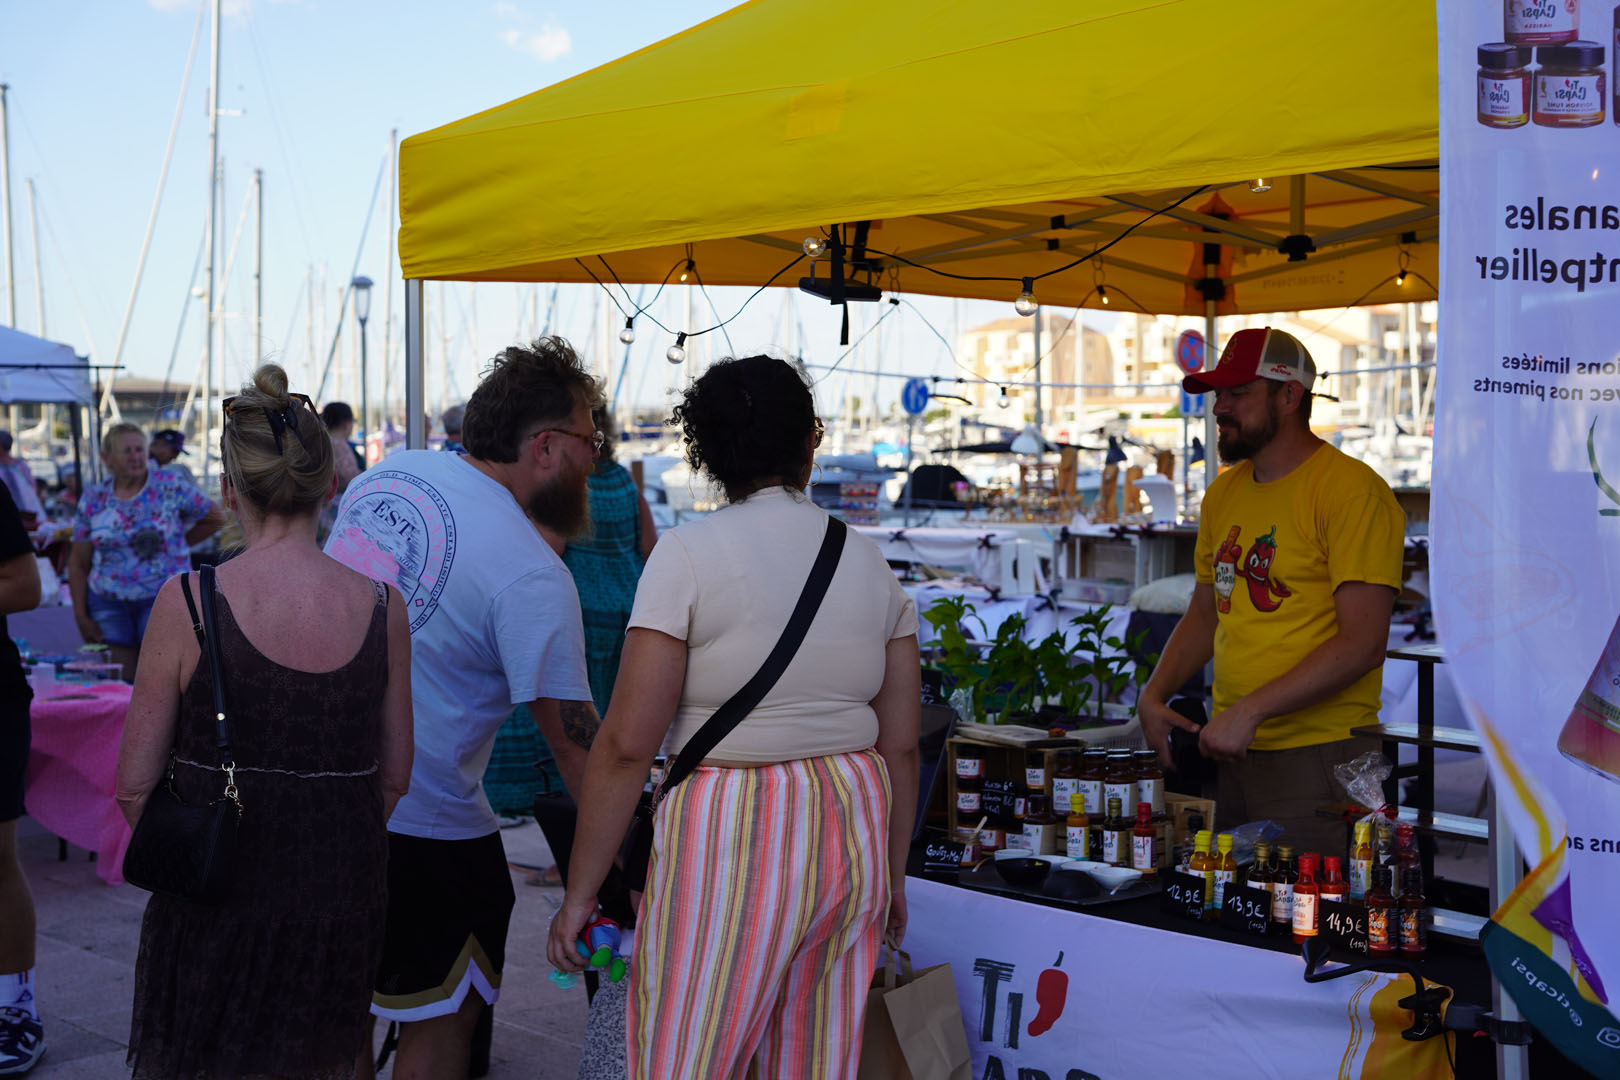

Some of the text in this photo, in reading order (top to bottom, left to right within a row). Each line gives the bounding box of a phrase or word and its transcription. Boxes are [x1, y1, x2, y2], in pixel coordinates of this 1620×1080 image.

[372, 500, 416, 542] EST.
[1166, 884, 1201, 903] 12,9€
[1227, 896, 1264, 918] 13,9€
[1325, 912, 1366, 935] 14,9€
